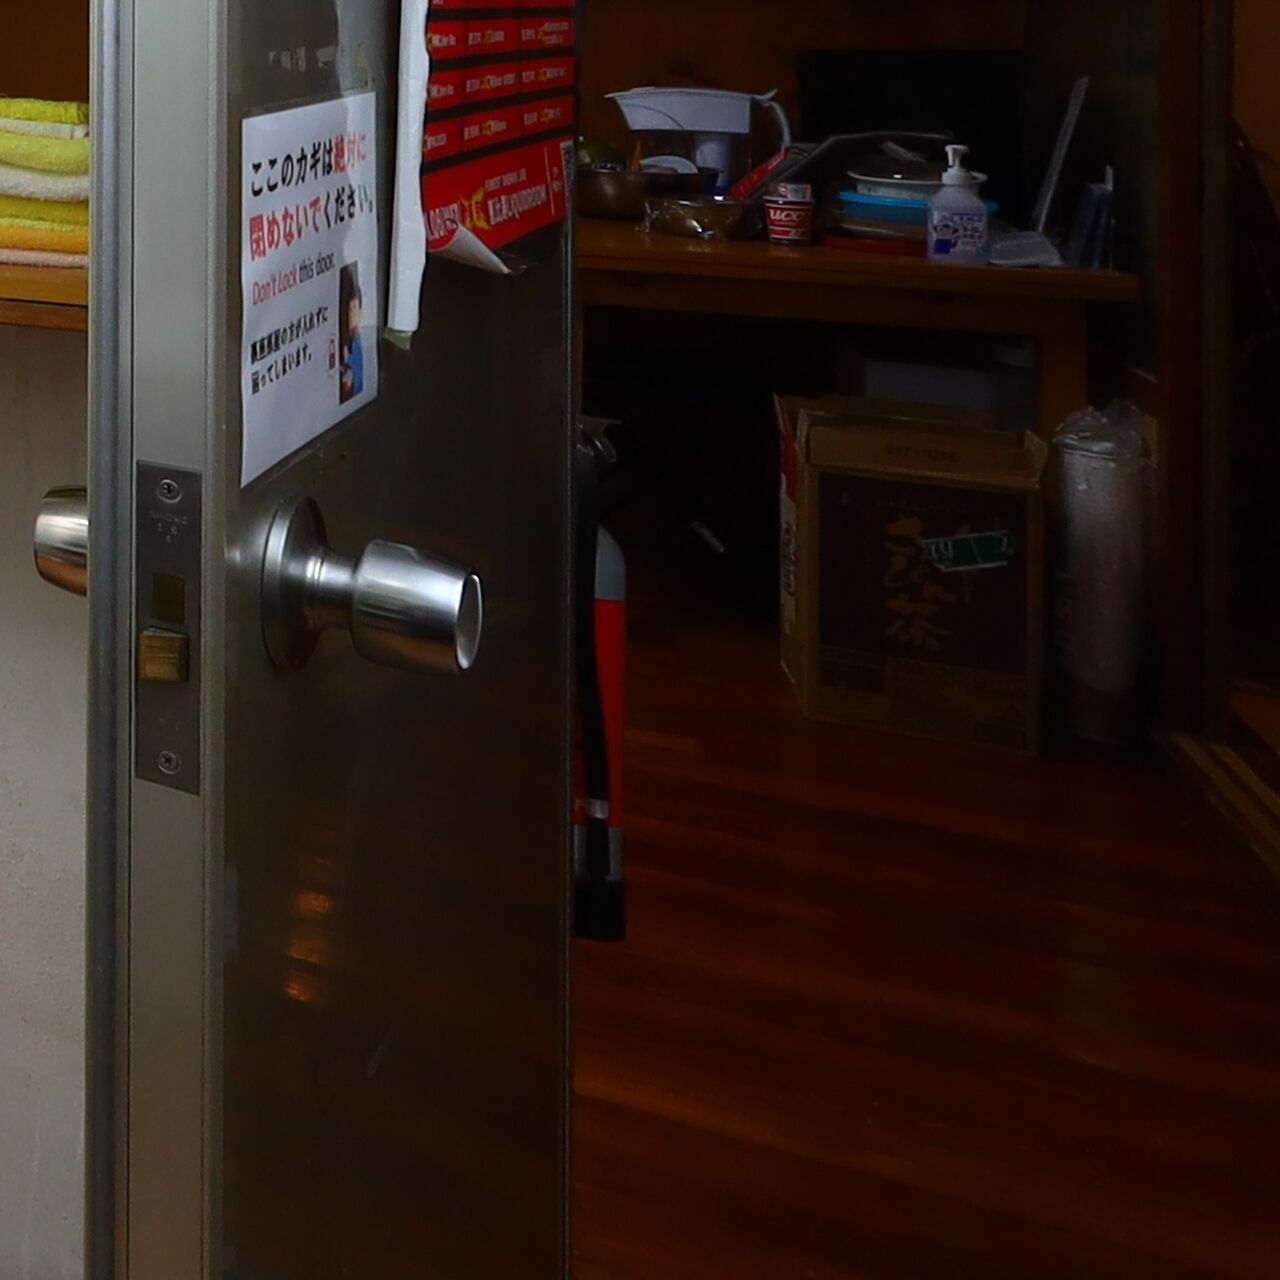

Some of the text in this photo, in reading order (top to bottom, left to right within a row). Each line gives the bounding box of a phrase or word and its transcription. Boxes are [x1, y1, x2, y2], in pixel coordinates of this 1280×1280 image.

[250, 132, 368, 198] ここのカギは絶対に
[249, 181, 375, 260] 閉めないでください。
[276, 269, 298, 297] Lock
[298, 259, 314, 285] this
